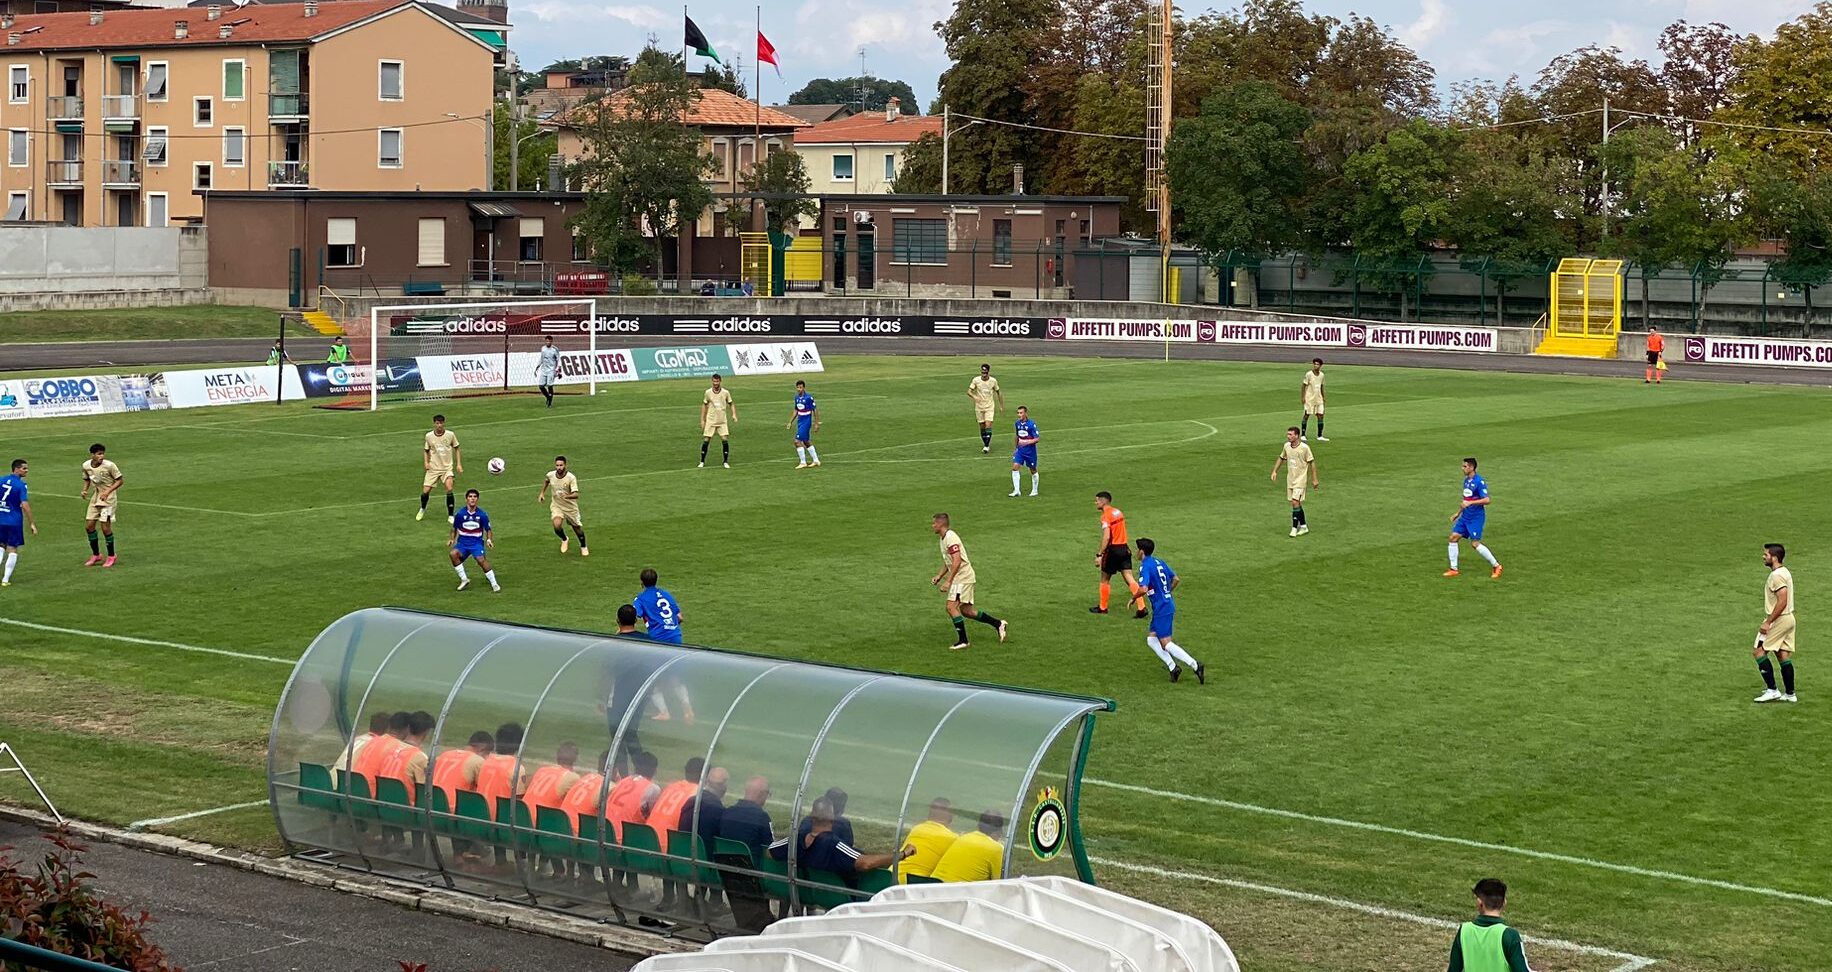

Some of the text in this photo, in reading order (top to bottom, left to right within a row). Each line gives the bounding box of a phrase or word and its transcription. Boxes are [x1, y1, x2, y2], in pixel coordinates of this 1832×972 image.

[446, 317, 506, 332] adidas
[579, 317, 640, 332] adidas
[711, 318, 771, 332] adidas
[842, 318, 901, 333] adidas
[971, 320, 1030, 335] adidas
[1071, 321, 1191, 338] AFFETTI PUMPS.COM
[1221, 324, 1342, 342] AFFETTI PUMPS.COM
[1371, 330, 1492, 348] AFFETTI PUMPS.COM
[1711, 342, 1759, 360] AFFETTI
[450, 359, 485, 371] META
[560, 353, 628, 376] GEARTEC
[205, 373, 245, 387] META
[26, 378, 97, 400] GOBBO
[1, 484, 12, 501] 7
[1156, 565, 1168, 586] 5
[656, 598, 673, 619] 3
[656, 790, 685, 816] 19
